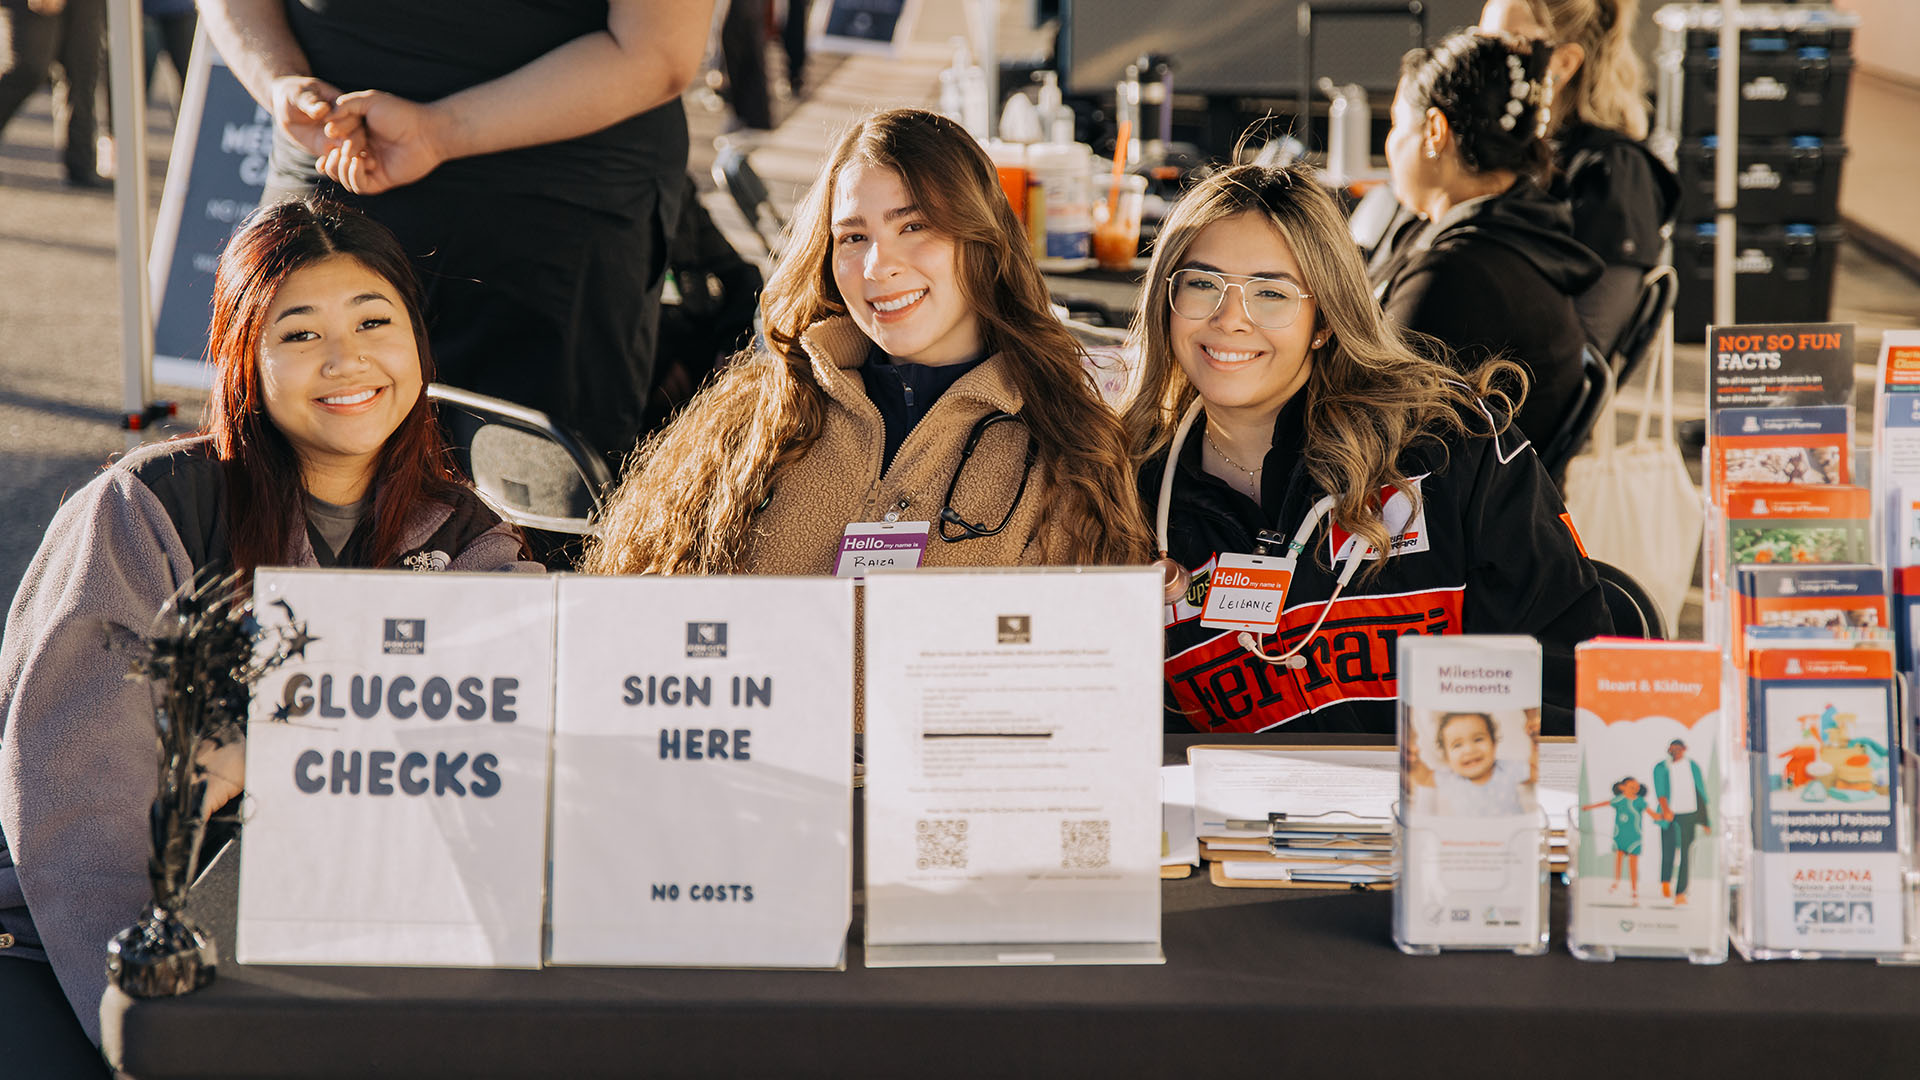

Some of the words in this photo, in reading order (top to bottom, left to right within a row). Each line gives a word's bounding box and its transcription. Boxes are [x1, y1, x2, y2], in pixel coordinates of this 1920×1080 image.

[1719, 336, 1764, 352] NOT
[1766, 335, 1795, 351] SO
[1798, 333, 1841, 350] FUN
[1717, 352, 1781, 371] FACTS
[844, 537, 884, 550] Hello
[1213, 571, 1250, 587] Hello
[1438, 665, 1512, 678] Milestone
[622, 675, 712, 707] SIGN
[731, 676, 773, 707] IN
[1440, 682, 1511, 695] Moments
[1597, 679, 1637, 692] Heart
[1639, 680, 1651, 691] &
[1653, 679, 1703, 696] Kidney
[283, 672, 519, 723] GLUCOSE
[659, 729, 752, 760] HERE
[294, 750, 502, 798] CHECKS
[1771, 813, 1840, 827] Household
[1841, 813, 1891, 826] Poisons
[1780, 831, 1819, 846] Safety
[1819, 831, 1831, 843] &
[1831, 831, 1859, 844] First
[1860, 831, 1883, 843] Aid
[1794, 869, 1873, 881] ARIZONA
[651, 884, 680, 901] NO
[690, 884, 755, 901] COSTS
